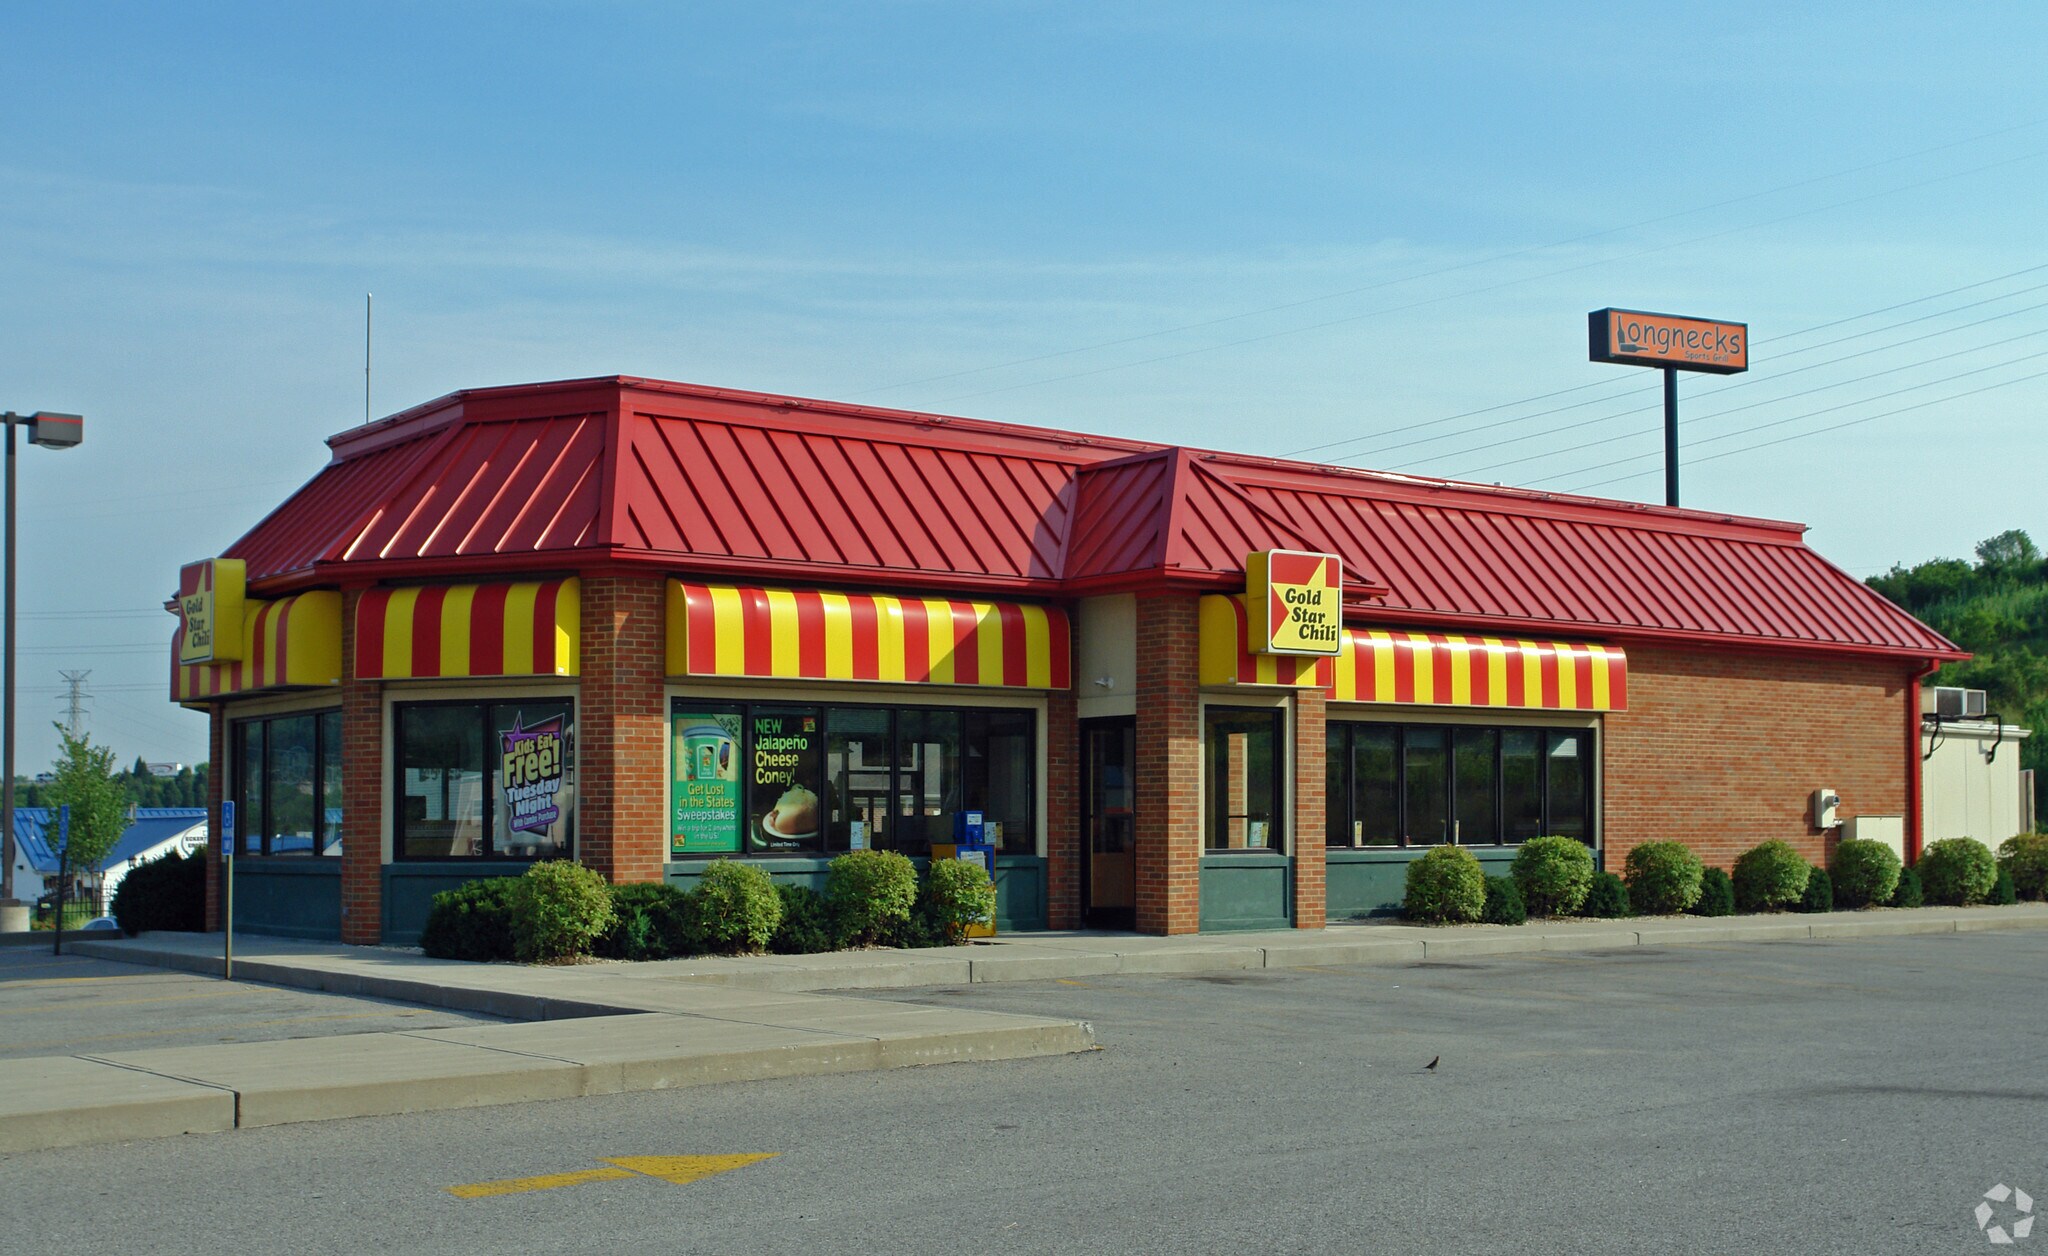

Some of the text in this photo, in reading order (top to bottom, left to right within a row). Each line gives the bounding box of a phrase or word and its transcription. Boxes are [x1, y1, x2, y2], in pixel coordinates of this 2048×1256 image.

[1684, 350, 1728, 363] Sports Grill
[186, 597, 203, 615] Gold
[1285, 588, 1322, 606] Gold
[1291, 606, 1326, 624] Star
[188, 617, 205, 632] Star
[1298, 623, 1336, 641] Chili
[191, 629, 210, 648] Chili
[755, 718, 783, 734] NEW
[514, 732, 553, 756] Kids Eat
[755, 734, 808, 753] Jalapeño
[503, 739, 560, 788] Free!
[755, 750, 799, 767] Cheese
[755, 767, 795, 787] Coney!
[507, 777, 560, 803] Tuesday
[687, 783, 724, 795] Get Lost
[515, 793, 552, 817] Night
[679, 795, 735, 808] in the States
[677, 808, 736, 822] Sweepstakes
